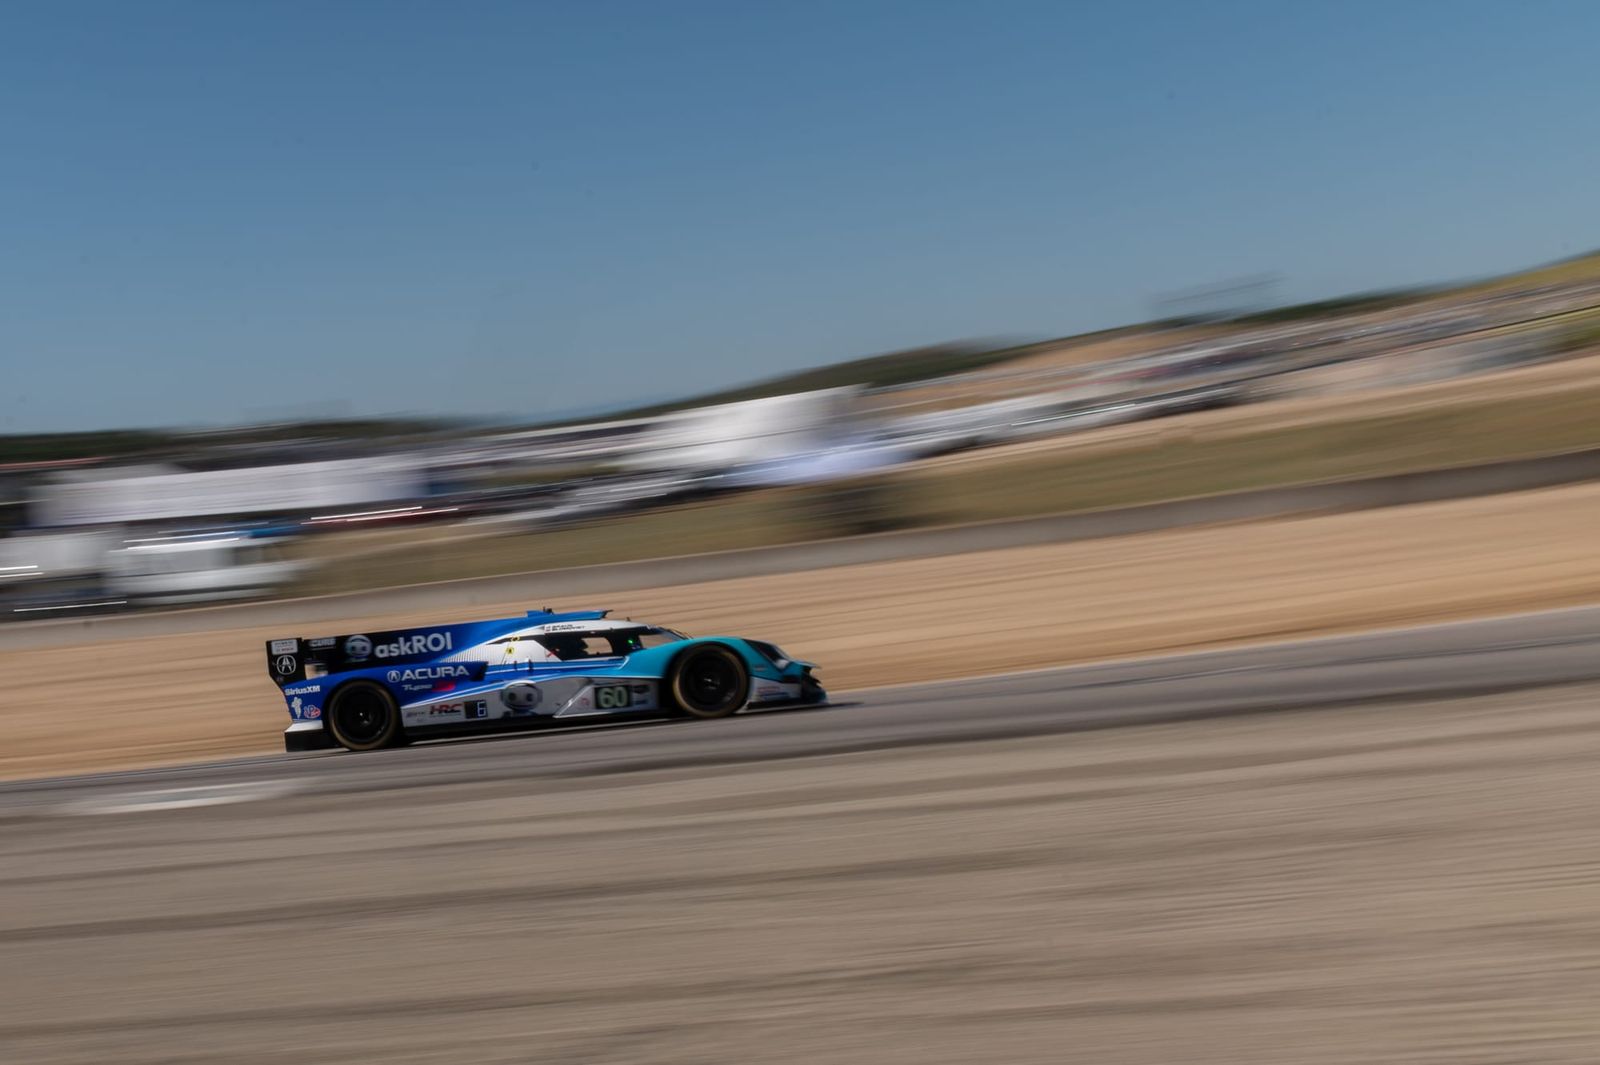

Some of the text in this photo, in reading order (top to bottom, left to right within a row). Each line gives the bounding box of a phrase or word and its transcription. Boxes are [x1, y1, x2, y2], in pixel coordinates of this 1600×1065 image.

[374, 632, 453, 658] askROI
[402, 665, 470, 681] ACURA
[284, 685, 321, 696] SiriusXM
[598, 686, 628, 708] 60
[429, 703, 463, 715] HRC
